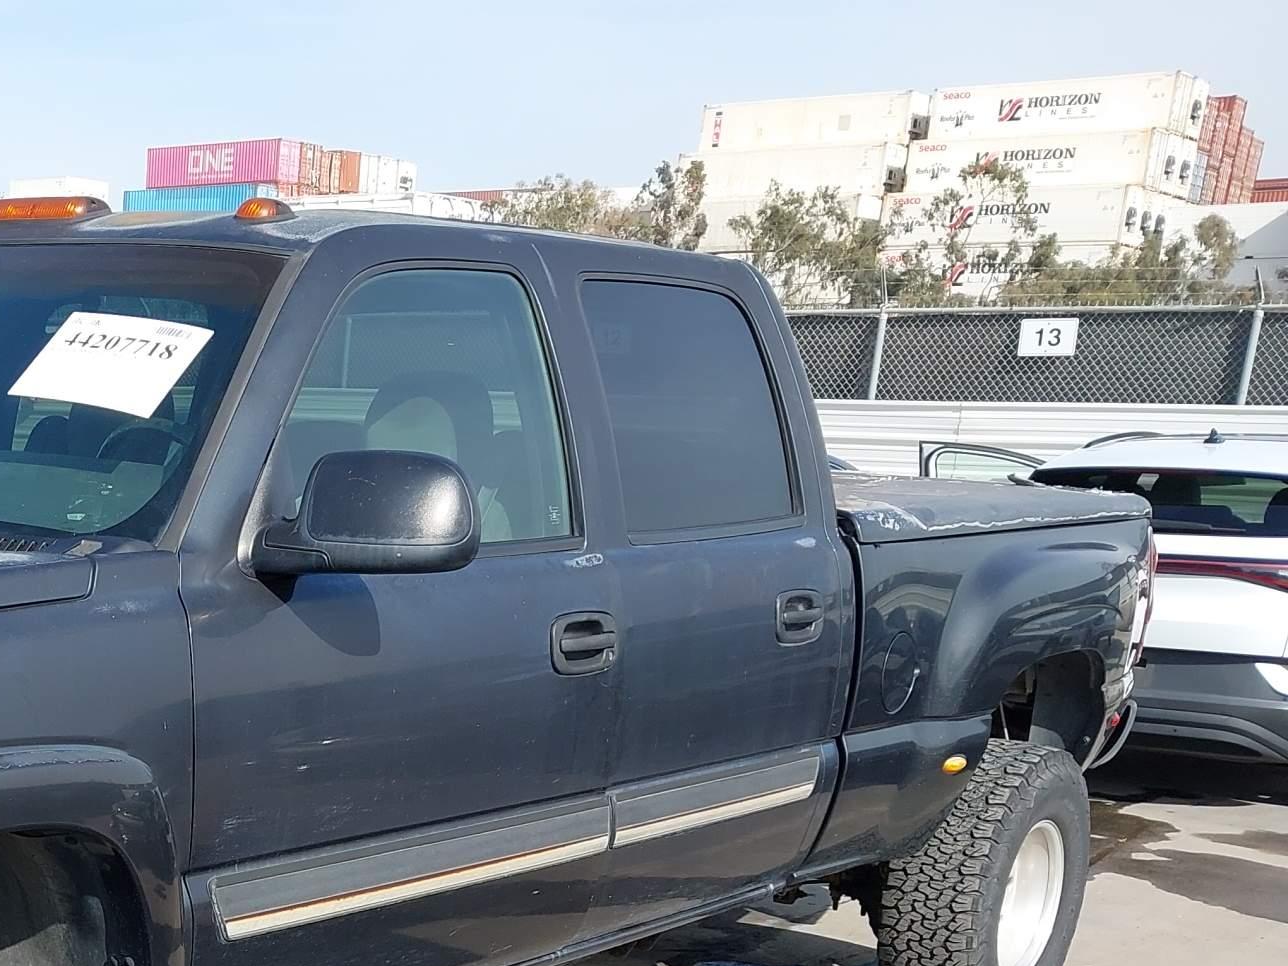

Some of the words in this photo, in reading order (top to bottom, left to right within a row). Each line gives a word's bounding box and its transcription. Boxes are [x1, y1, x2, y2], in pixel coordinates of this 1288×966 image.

[943, 91, 971, 101] seaco
[1027, 92, 1102, 109] HORIZON
[1024, 107, 1088, 117] LINES
[919, 144, 948, 152] seaco
[1003, 147, 1077, 162] HORIZON
[188, 148, 234, 173] ONE
[978, 202, 1051, 216] HORIZON
[1035, 328, 1061, 347] 13
[64, 332, 178, 360] 44207718
